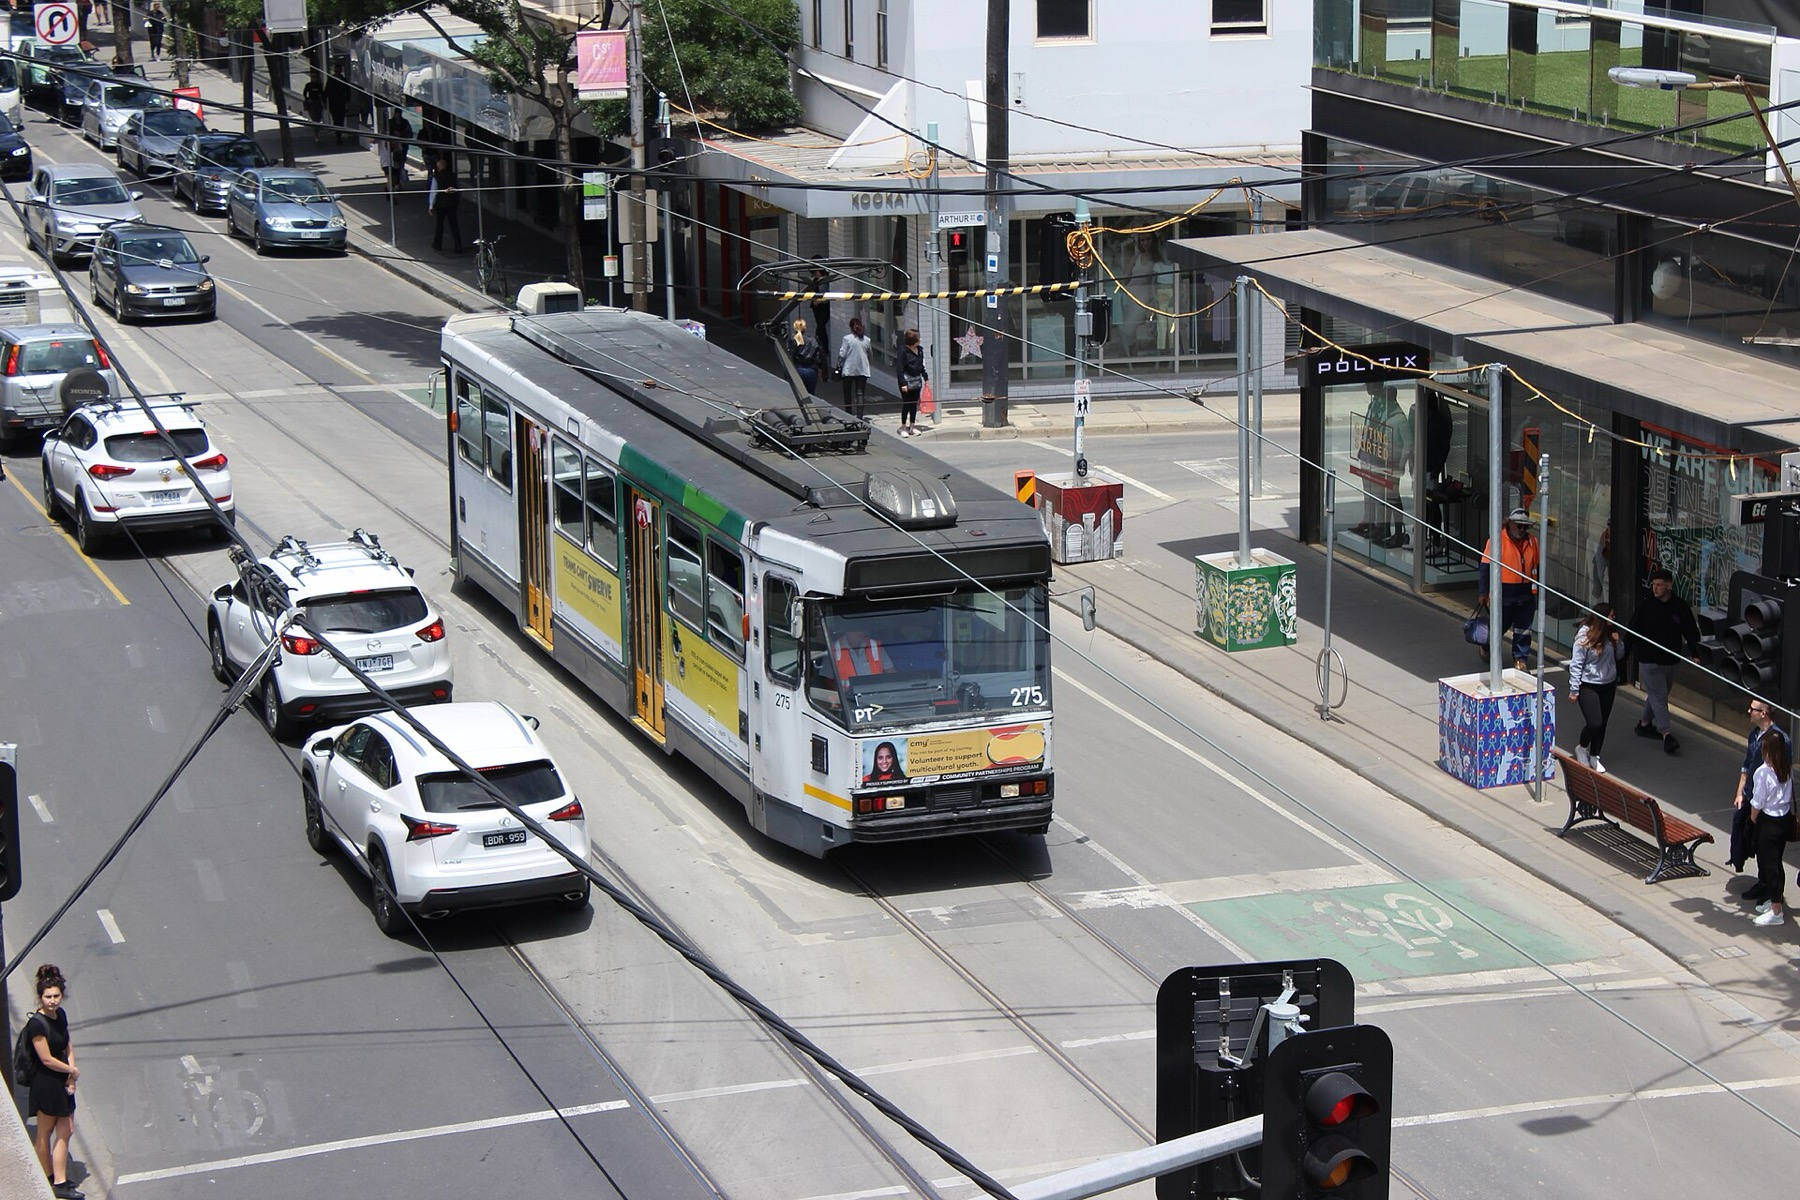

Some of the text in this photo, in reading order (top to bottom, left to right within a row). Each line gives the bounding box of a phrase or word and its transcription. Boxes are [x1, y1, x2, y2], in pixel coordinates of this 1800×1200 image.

[940, 215, 969, 223] ARTHUR
[1318, 355, 1417, 375] POLITIX
[1354, 438, 1389, 460] SORTED
[1640, 430, 1671, 469] WE
[1674, 444, 1717, 486] ARE
[588, 575, 612, 600] SWERVE
[776, 693, 790, 709] 275
[1011, 686, 1042, 706] 275
[955, 752, 982, 761] support
[910, 761, 979, 773] multicultural youth.
[942, 771, 974, 780] COMMUNITY
[975, 767, 1012, 776] PARTNERSHIPS
[1014, 763, 1039, 772] PROGRAM
